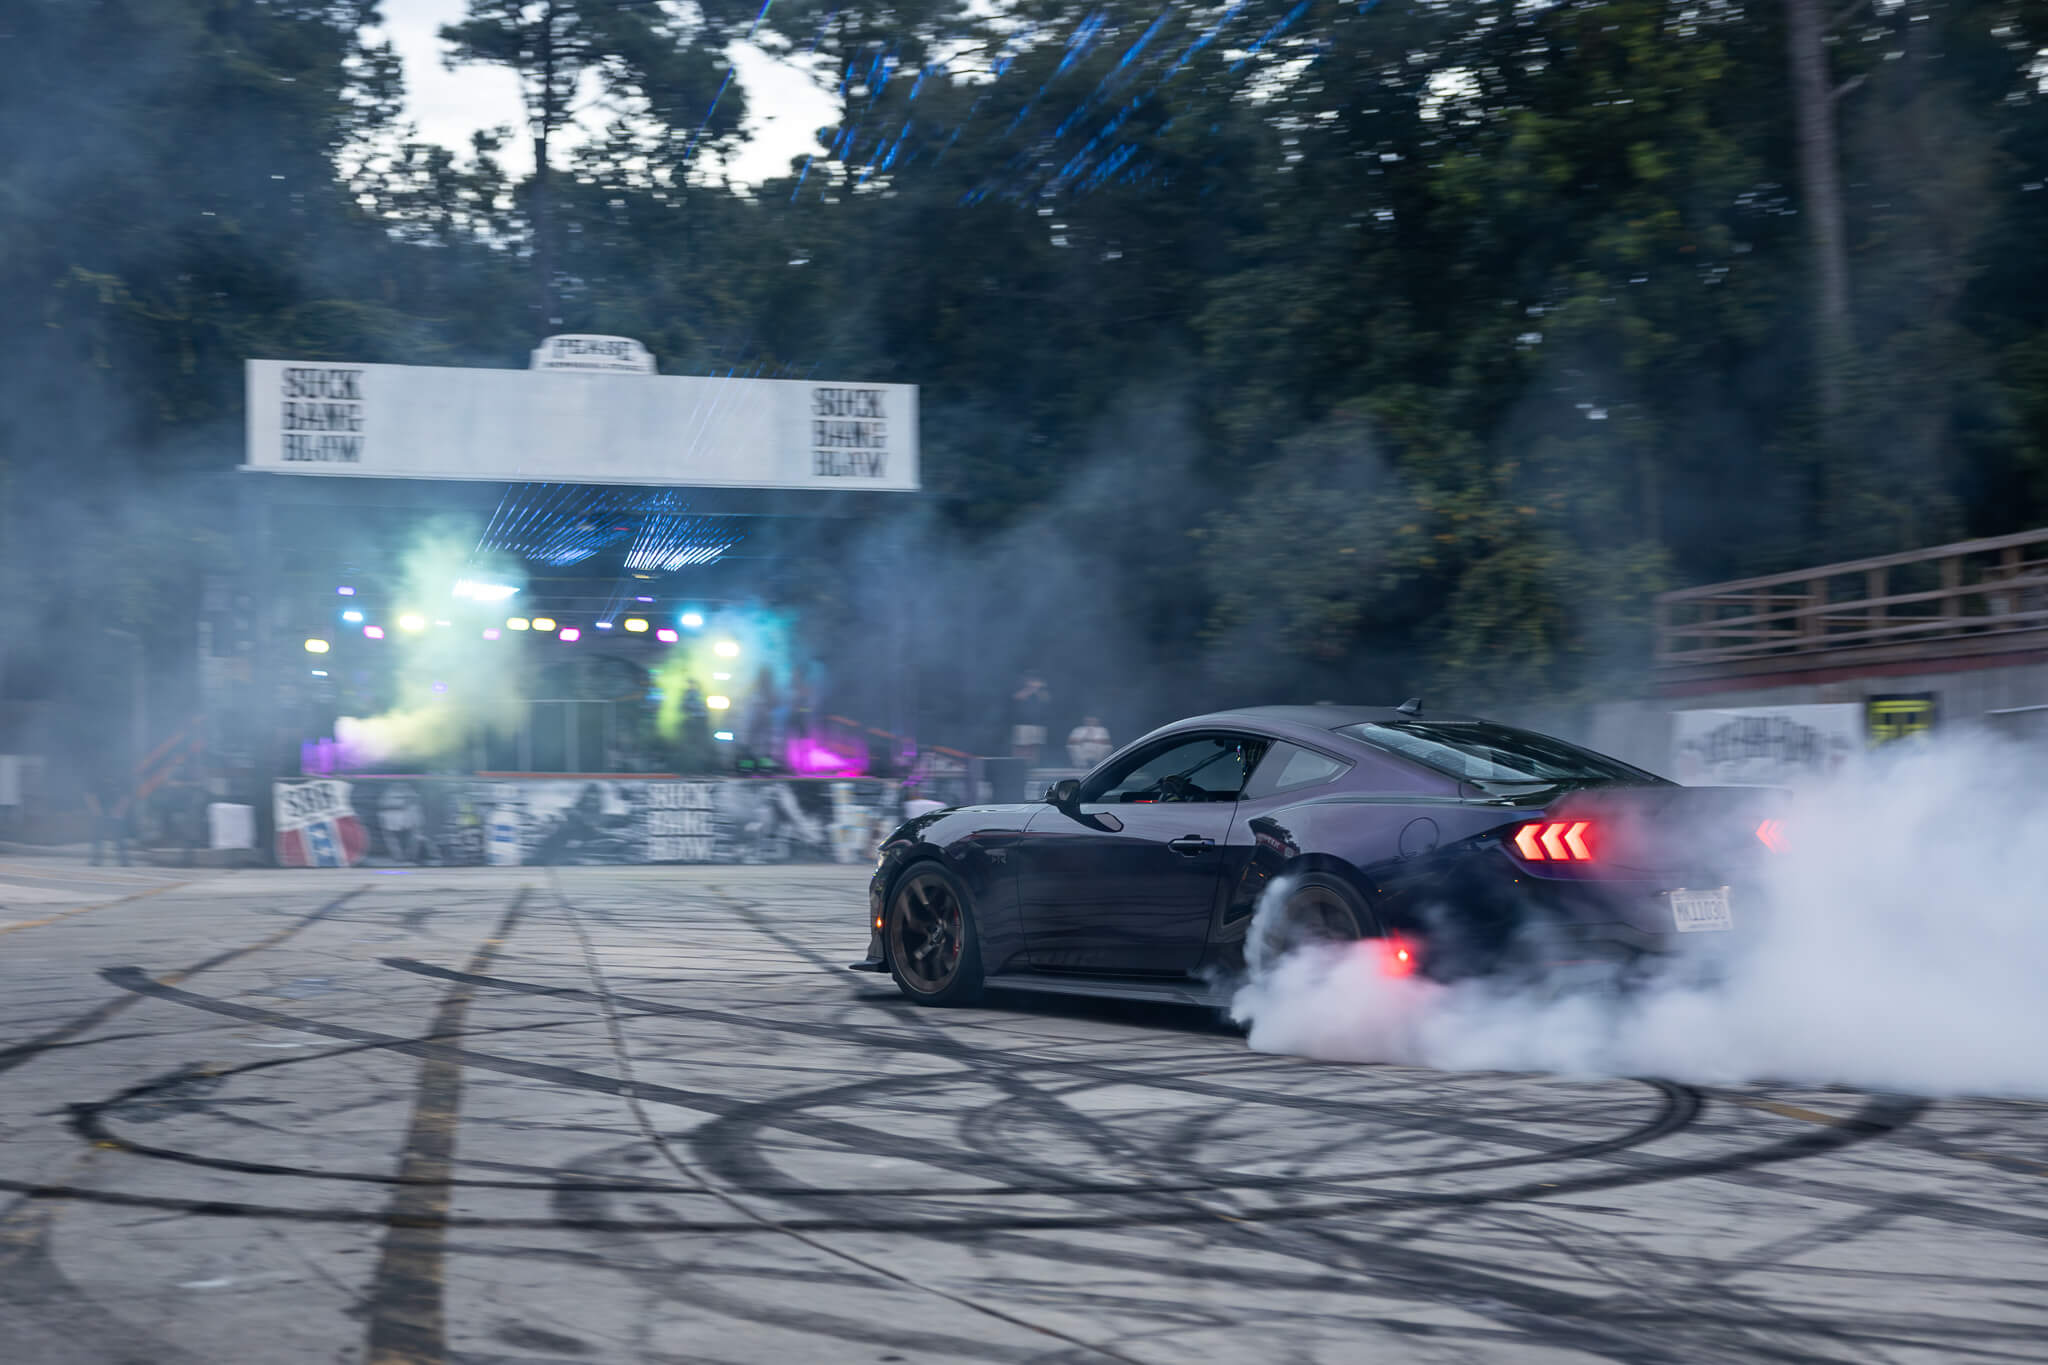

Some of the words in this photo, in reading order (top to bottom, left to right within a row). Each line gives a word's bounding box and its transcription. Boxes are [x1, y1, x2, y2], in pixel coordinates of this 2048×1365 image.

[282, 367, 365, 400] SUCK
[810, 387, 888, 418] SUCK
[281, 433, 366, 463] BLOW
[811, 449, 889, 478] BLOW
